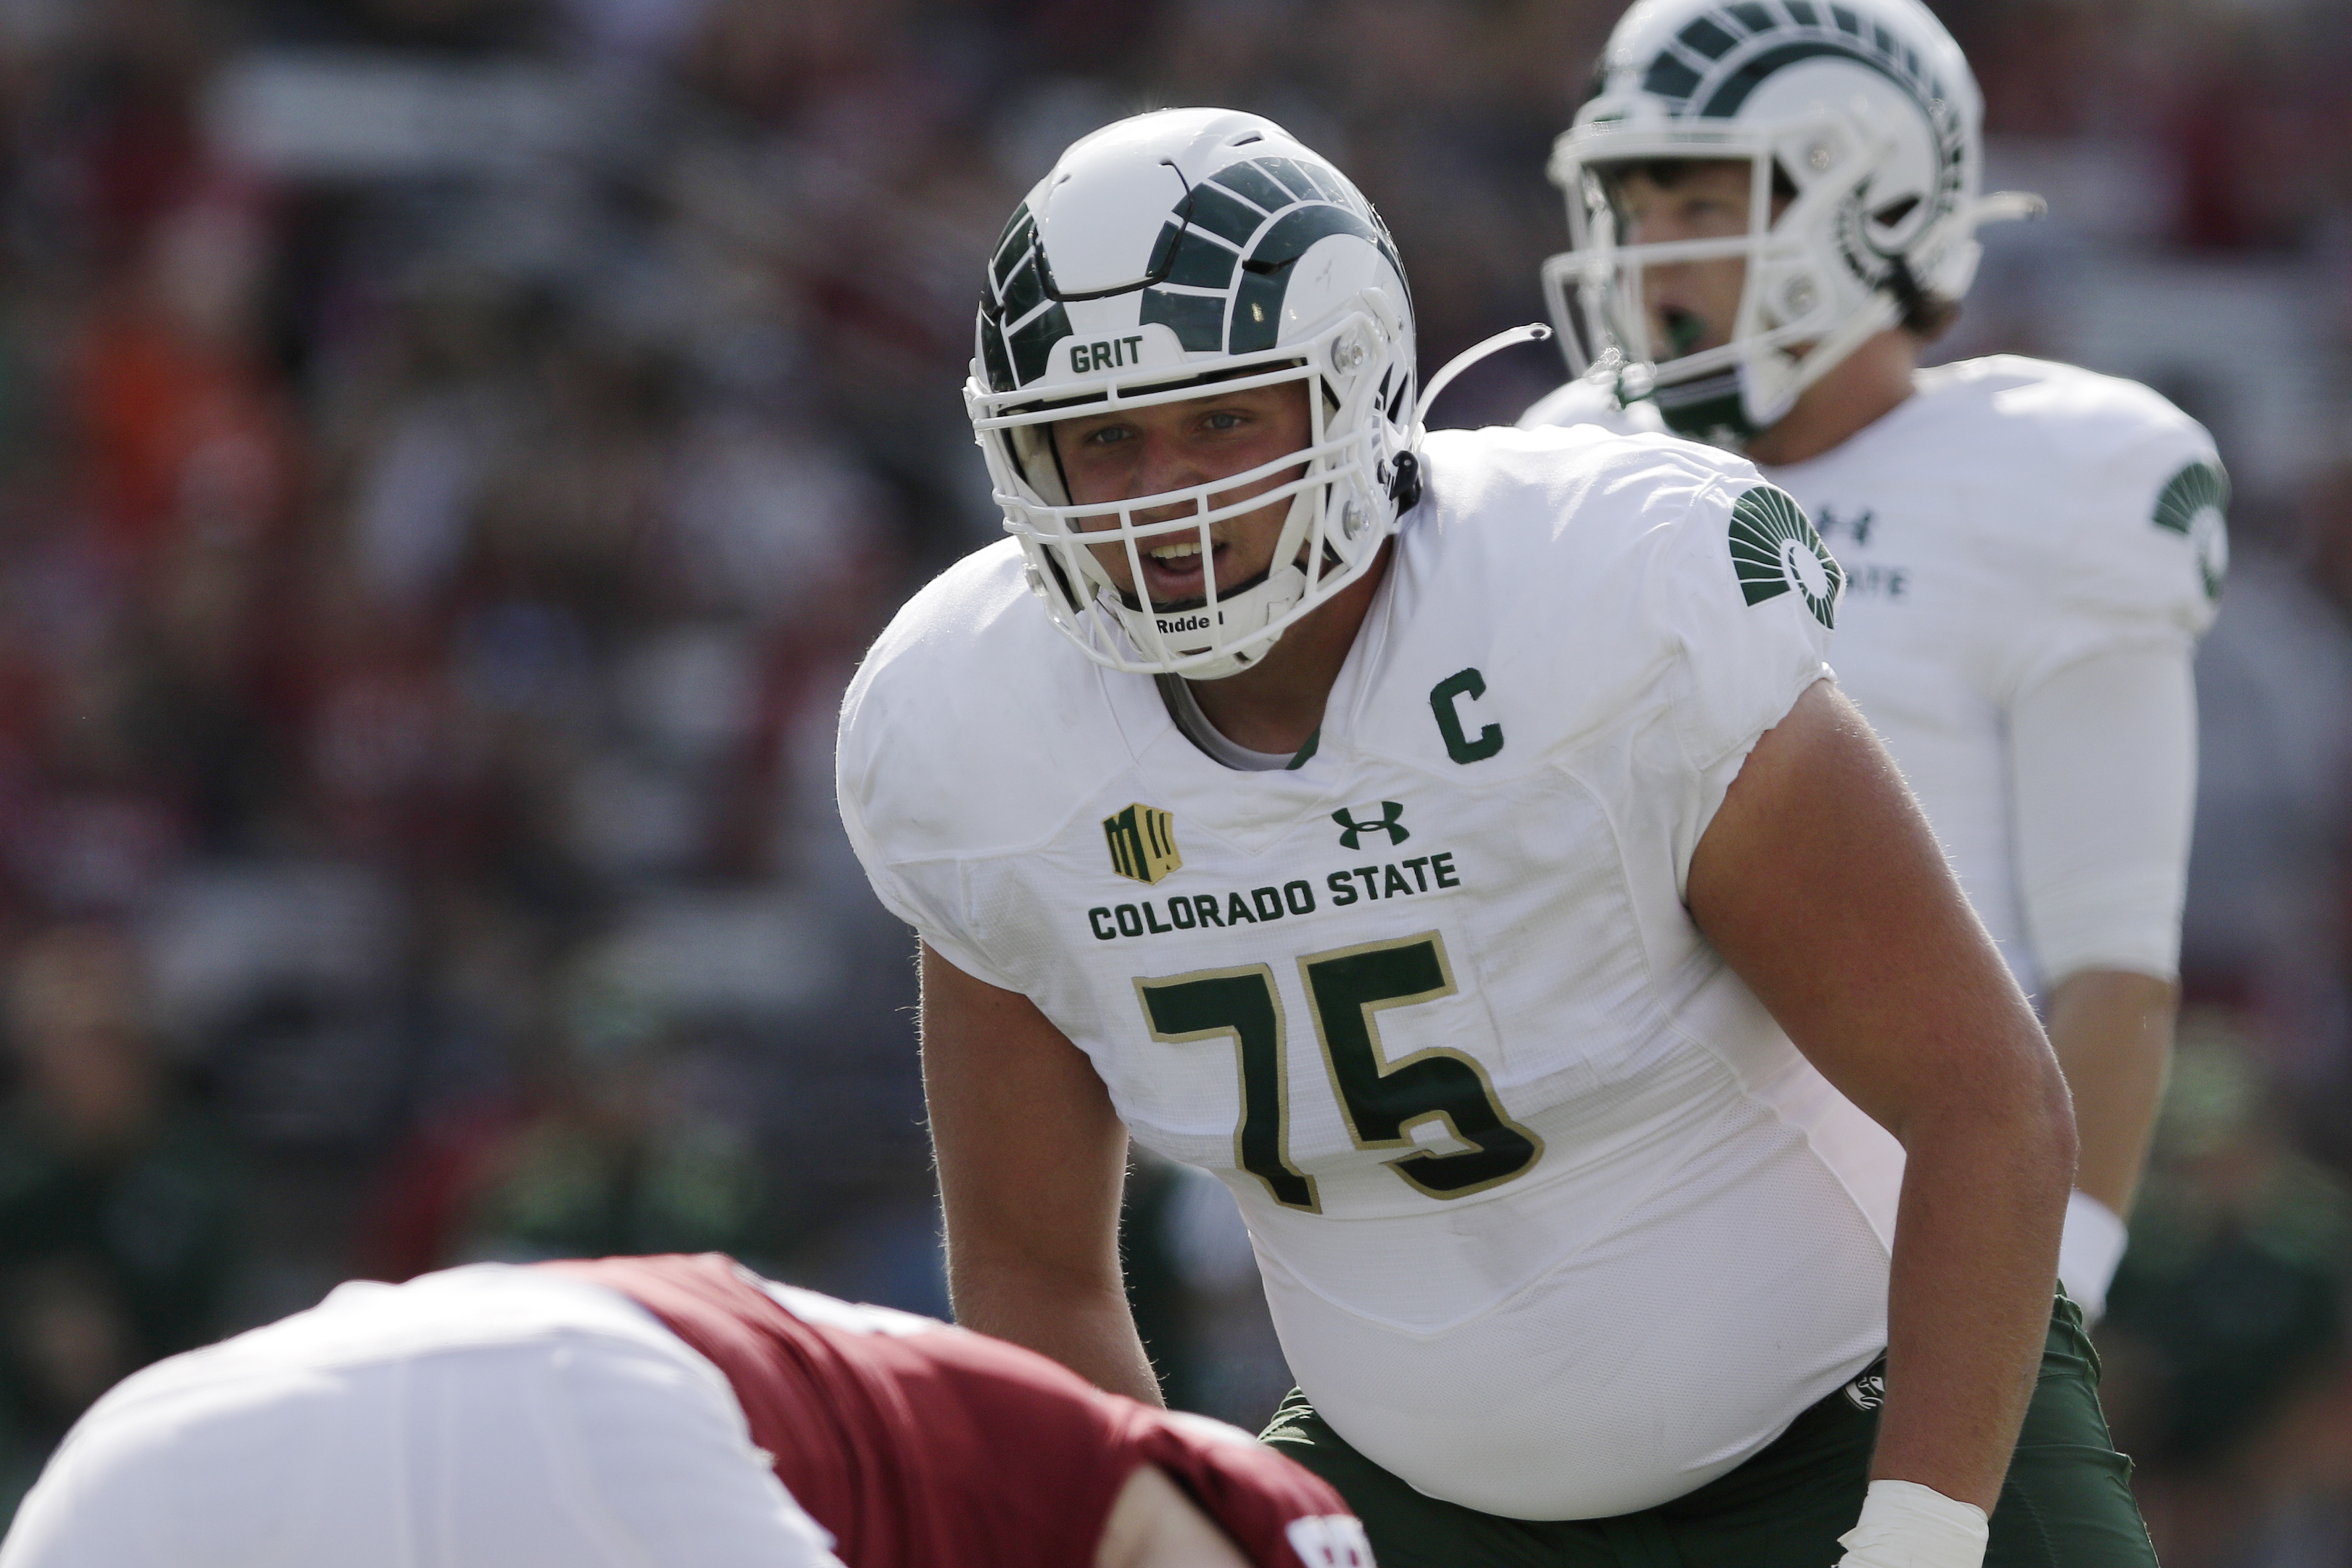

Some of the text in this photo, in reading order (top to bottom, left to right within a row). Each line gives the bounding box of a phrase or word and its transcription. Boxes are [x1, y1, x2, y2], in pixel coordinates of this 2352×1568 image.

[1070, 335, 1143, 374] GRIT
[1155, 610, 1224, 634] Riddel
[1429, 667, 1505, 765] C
[1088, 852, 1460, 940] COLORADO STATE
[1131, 929, 1546, 1214] 75
